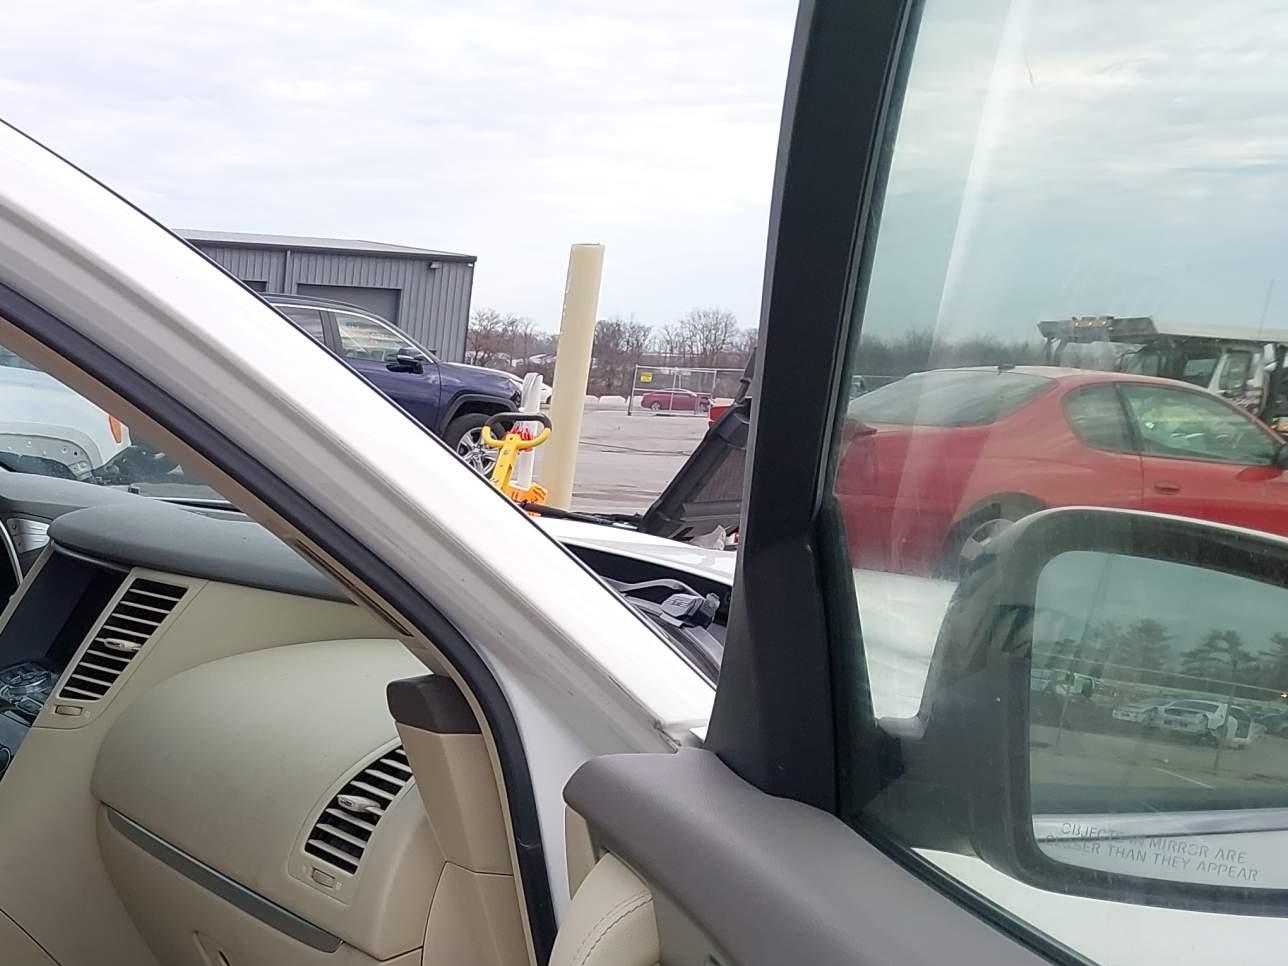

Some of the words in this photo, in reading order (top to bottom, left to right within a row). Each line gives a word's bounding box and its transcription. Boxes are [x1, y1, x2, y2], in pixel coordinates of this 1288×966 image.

[1062, 822, 1126, 844] OBJECT
[1149, 838, 1209, 858] MIRROR
[1214, 848, 1248, 864] ARE
[1107, 844, 1147, 863] THAN
[1153, 852, 1192, 870] THEY
[1196, 860, 1259, 881] APPEAR
